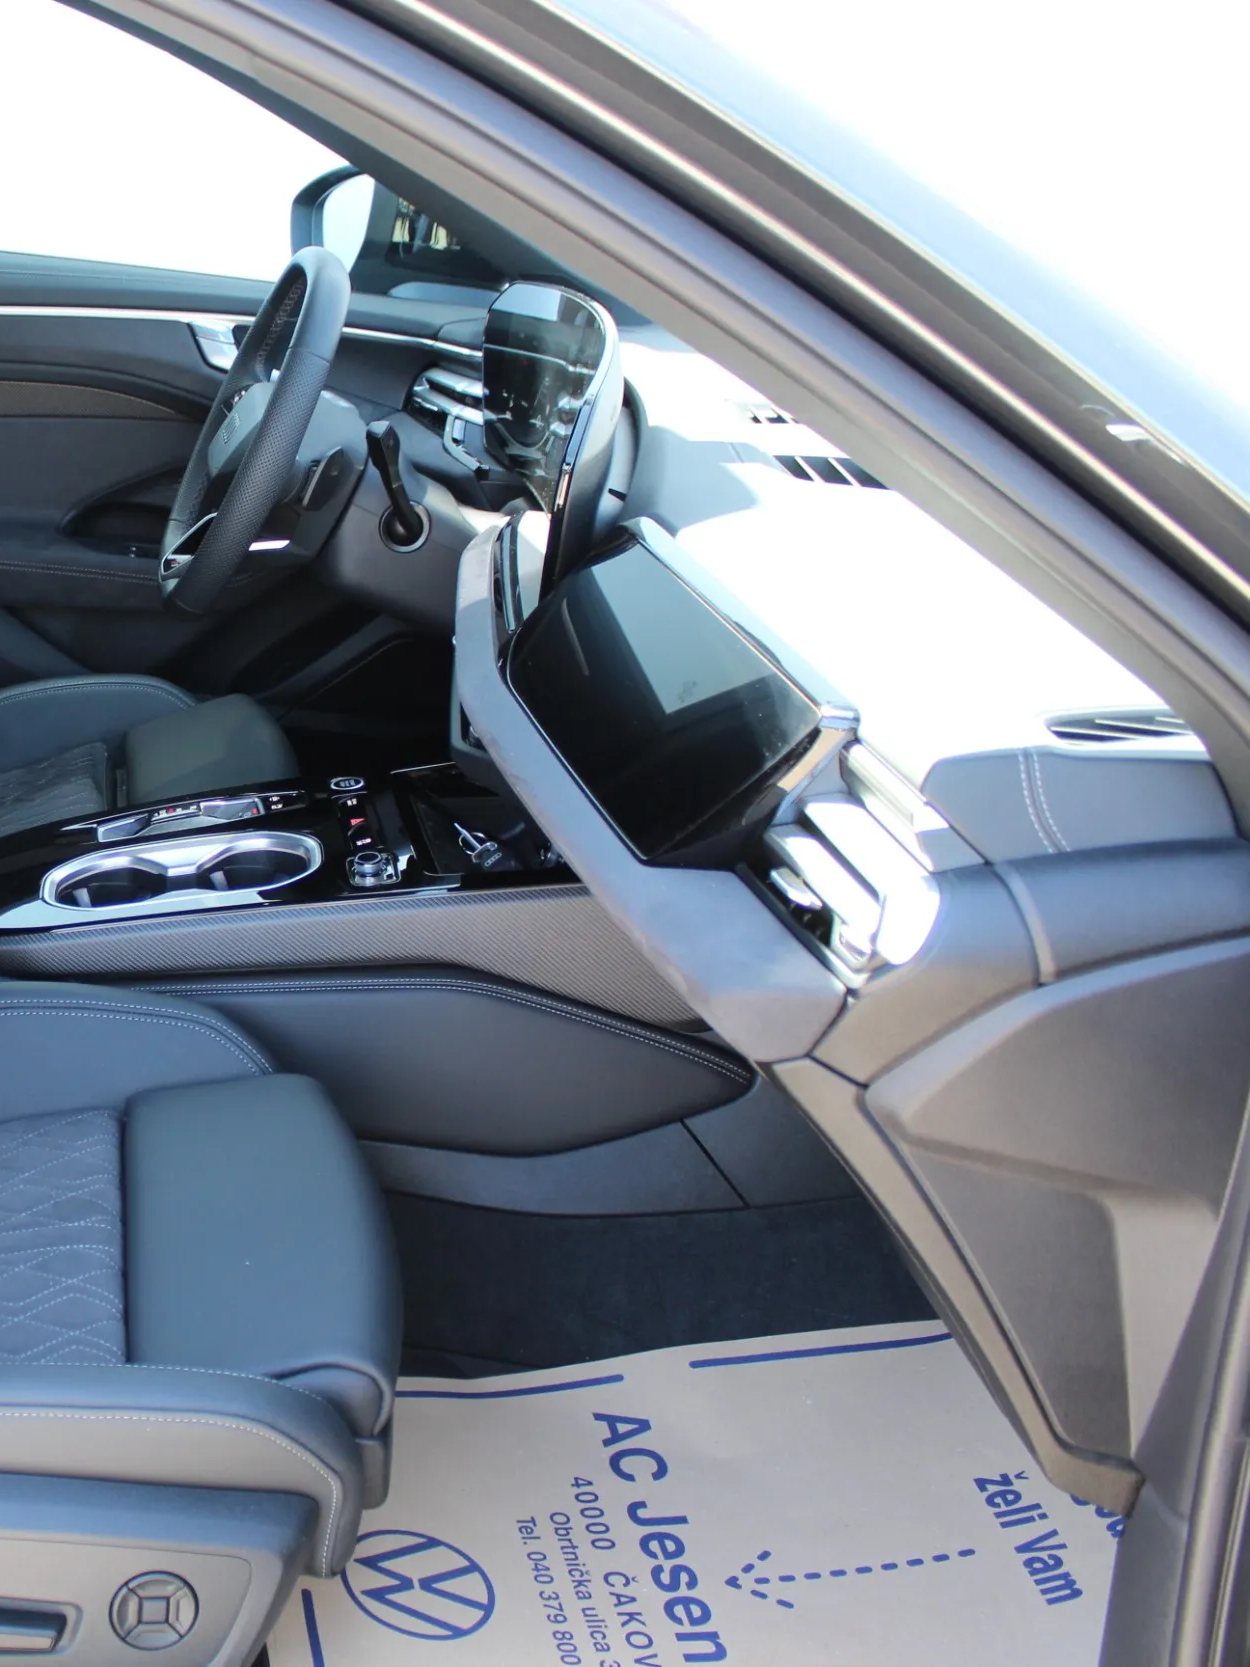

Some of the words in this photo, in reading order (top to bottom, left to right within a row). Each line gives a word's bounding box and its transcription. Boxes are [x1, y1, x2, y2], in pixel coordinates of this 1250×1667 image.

[592, 1412, 668, 1482] AC
[516, 1516, 541, 1545] Tel.
[571, 1476, 616, 1550] 40000
[973, 1470, 1049, 1529] želi
[1014, 1528, 1083, 1605] Vam
[526, 1551, 555, 1585] 040
[549, 1512, 592, 1600] Obrtnička
[581, 1607, 611, 1652] ulica
[626, 1501, 727, 1663] Jesen
[539, 1590, 567, 1624] 379
[552, 1630, 581, 1666] 800
